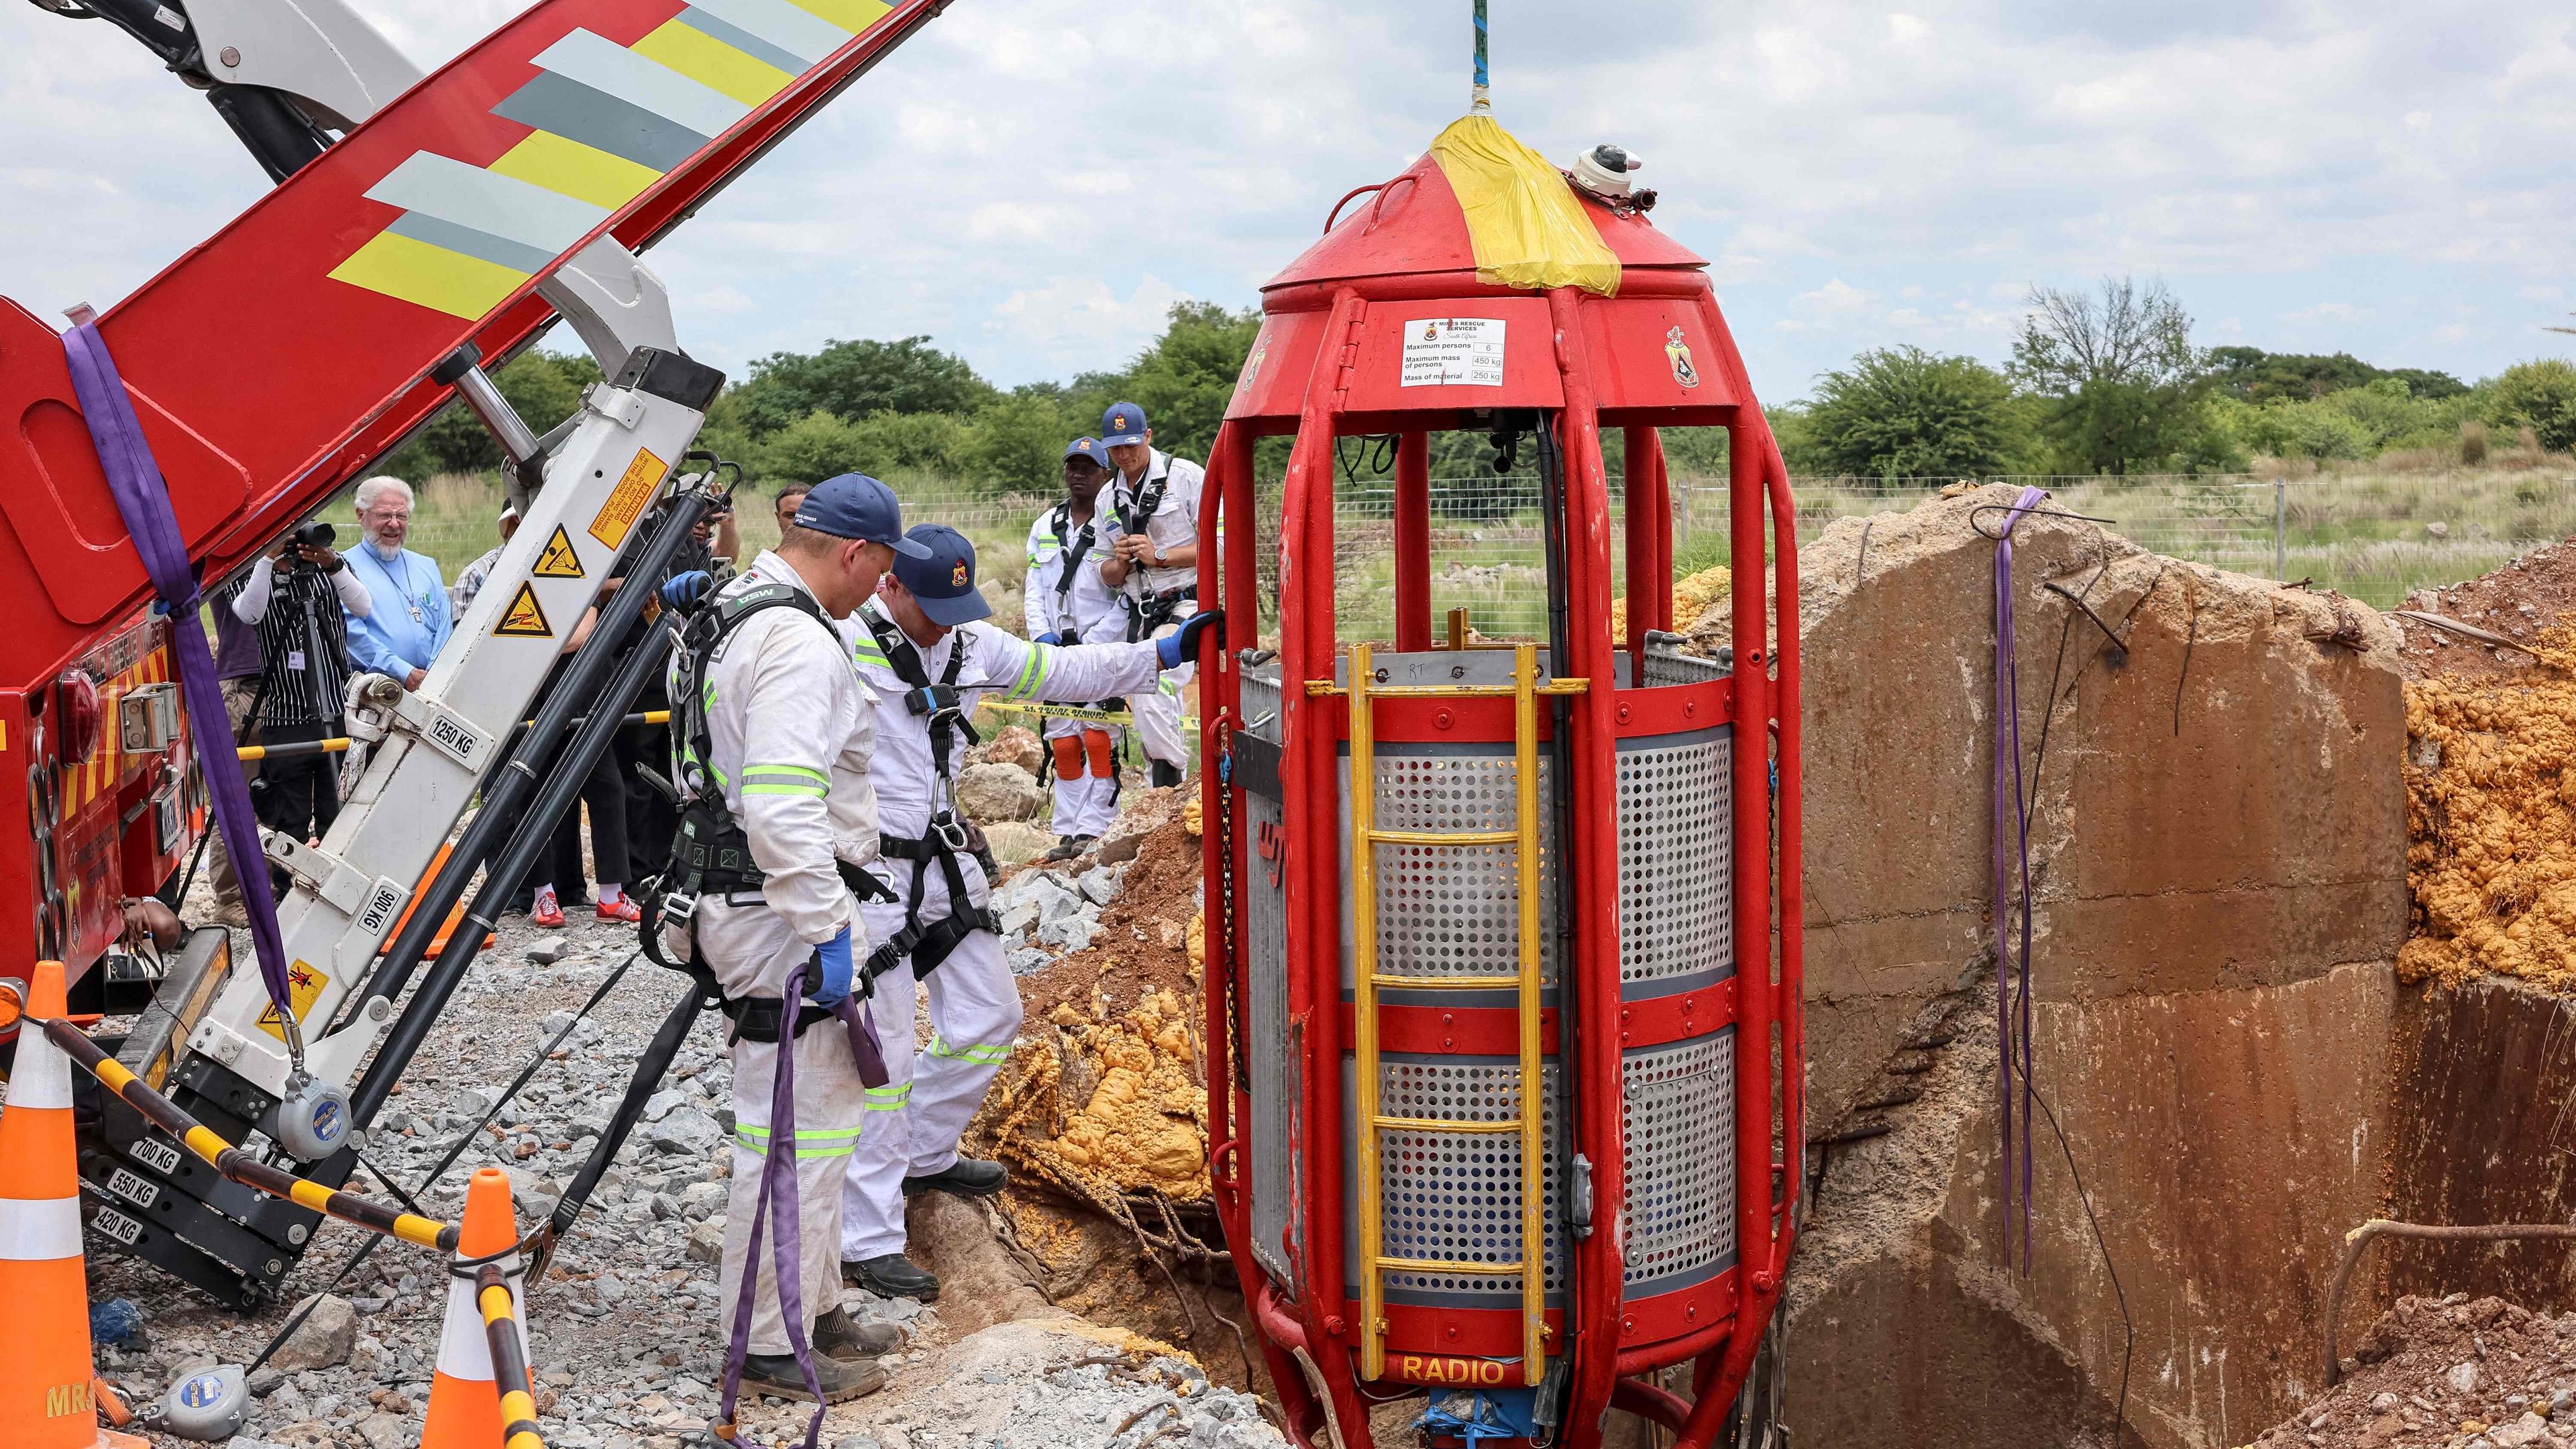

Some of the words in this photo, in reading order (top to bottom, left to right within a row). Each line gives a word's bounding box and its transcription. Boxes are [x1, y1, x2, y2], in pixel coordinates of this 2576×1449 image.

[1406, 343, 1440, 351] Maximum
[1413, 362, 1443, 370] persons
[1491, 358, 1501, 366] kg
[1491, 373, 1501, 381] kg
[639, 453, 645, 462] OF
[629, 463, 639, 475] THE
[635, 458, 650, 477] WITHIN
[616, 476, 631, 494] BOOM
[637, 476, 644, 486] DO
[613, 480, 635, 511] OPERATING
[629, 488, 637, 500] NOT
[614, 501, 628, 521] STAND
[621, 484, 650, 523] WARNING
[594, 500, 615, 531] PLATFORM
[599, 515, 614, 533] RANGE
[737, 589, 773, 604] MSA
[433, 719, 458, 744] 1250
[454, 733, 473, 753] KG
[374, 890, 395, 912] 900
[364, 910, 384, 928] KG
[136, 1141, 158, 1161] 700
[154, 1149, 175, 1169] KG
[113, 1173, 136, 1195] 550
[133, 1183, 153, 1203] KG
[97, 1210, 120, 1232] 420
[117, 1220, 137, 1240] KG
[1403, 1356, 1504, 1384] RADIO
